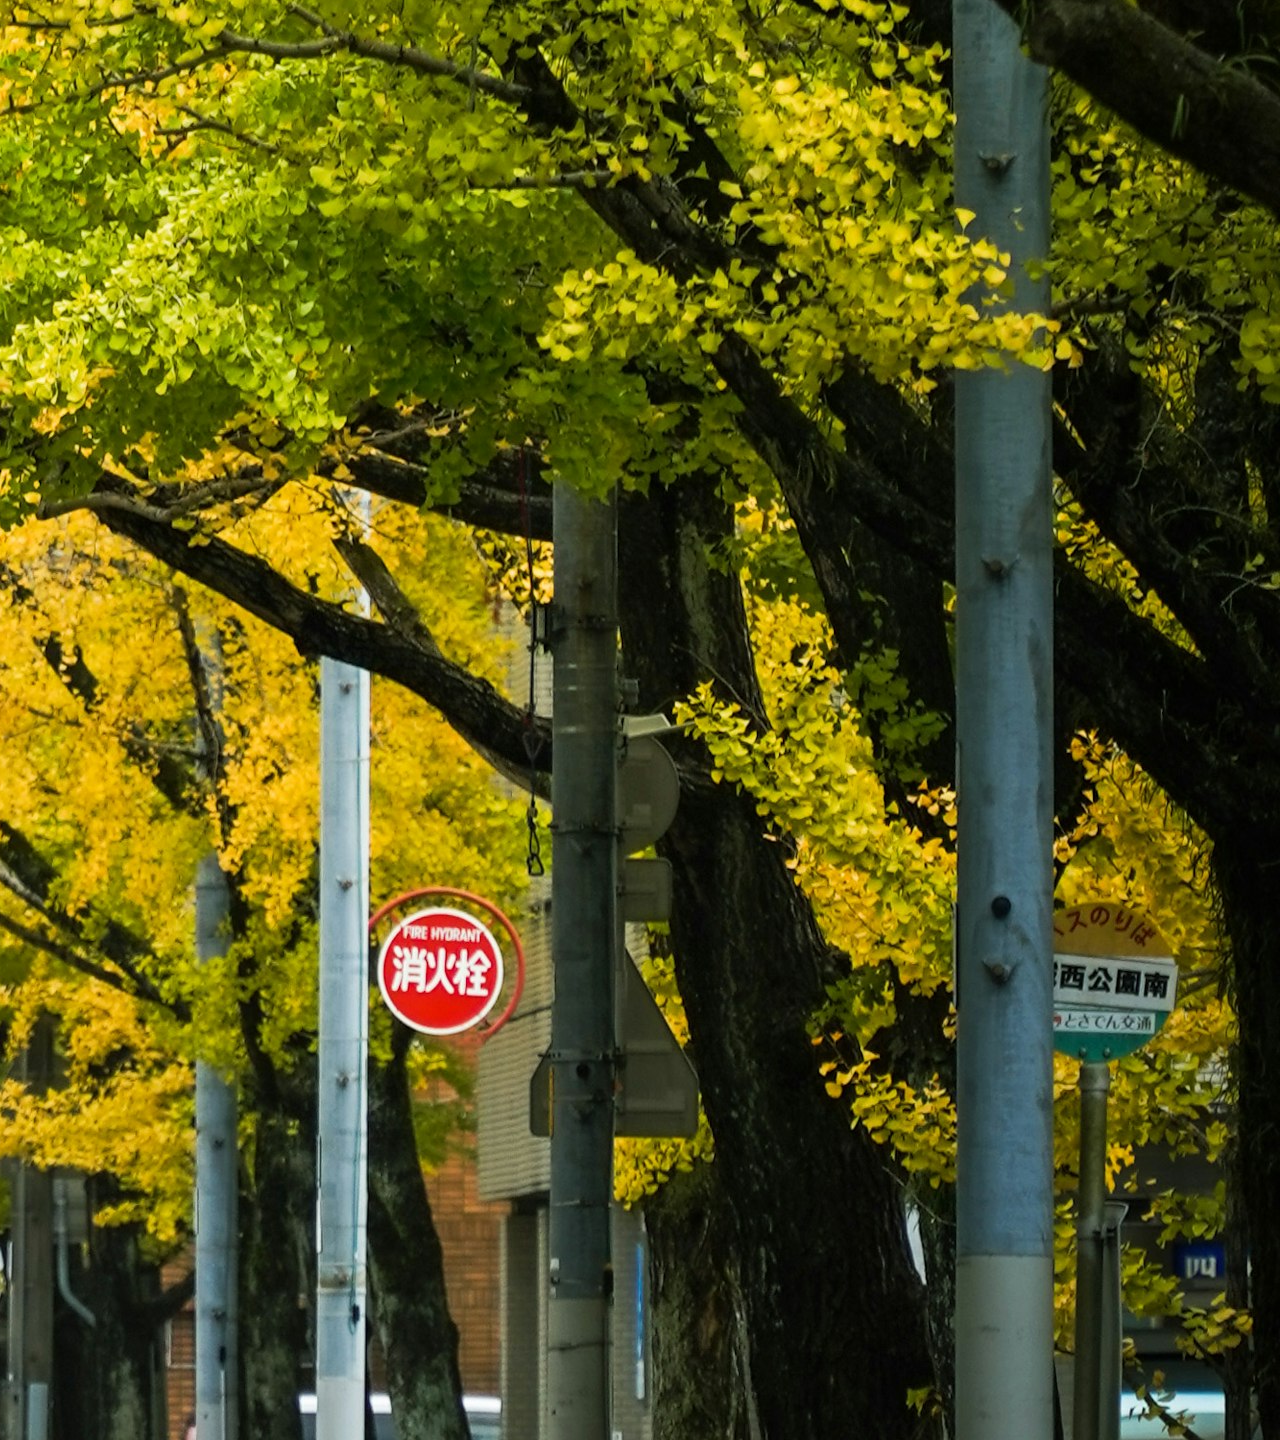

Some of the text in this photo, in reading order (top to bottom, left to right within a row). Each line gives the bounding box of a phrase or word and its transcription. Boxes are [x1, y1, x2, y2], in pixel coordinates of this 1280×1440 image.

[403, 925, 481, 942] FIRE HYDRANT
[391, 945, 492, 996] 消火栓
[1054, 962, 1170, 999] 西公園南
